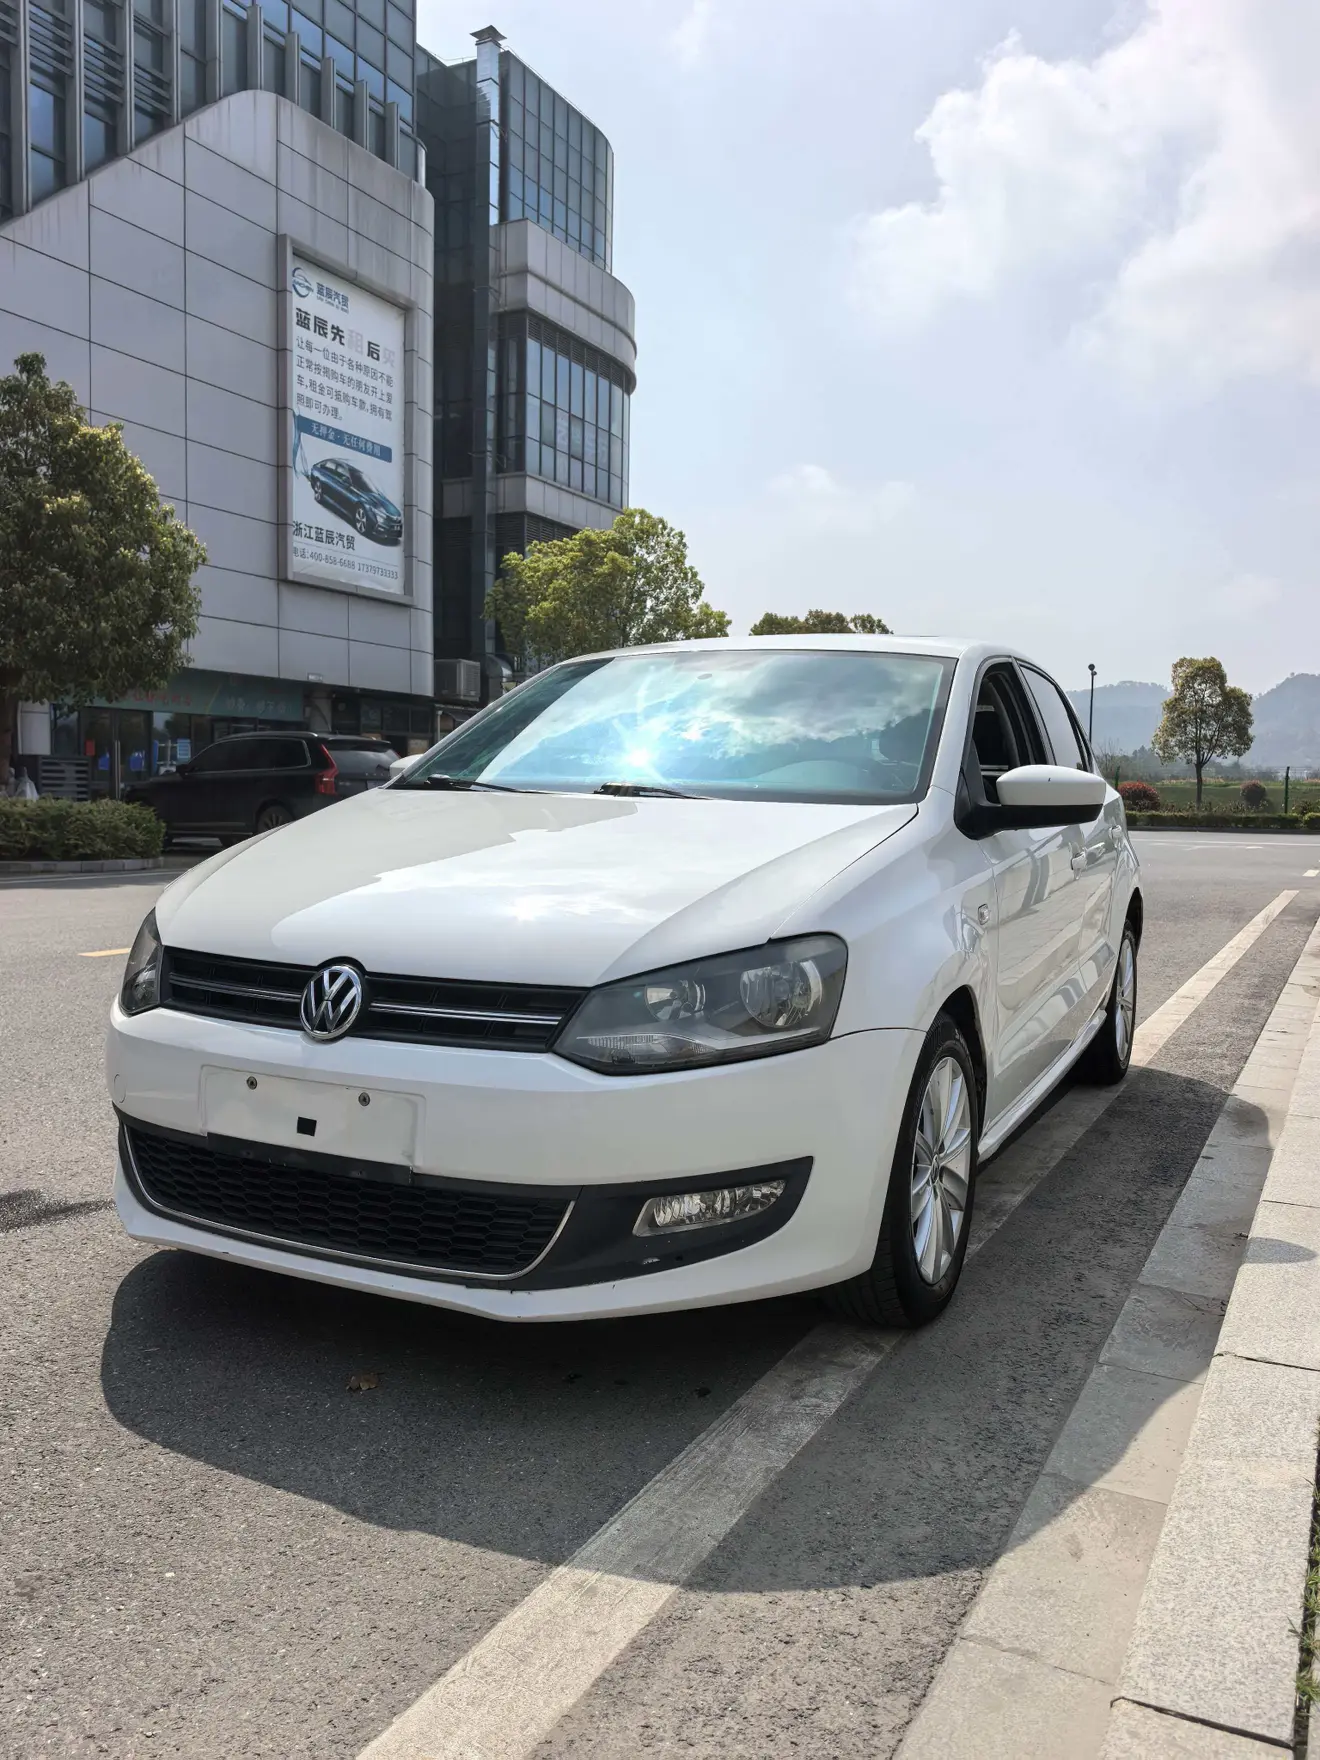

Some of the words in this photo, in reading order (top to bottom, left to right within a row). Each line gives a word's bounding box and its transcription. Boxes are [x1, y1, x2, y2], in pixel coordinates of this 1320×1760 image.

[296, 336, 394, 388] 让每一位由于各种原因不能
[293, 520, 356, 551] 浙江蓝辰汽贸
